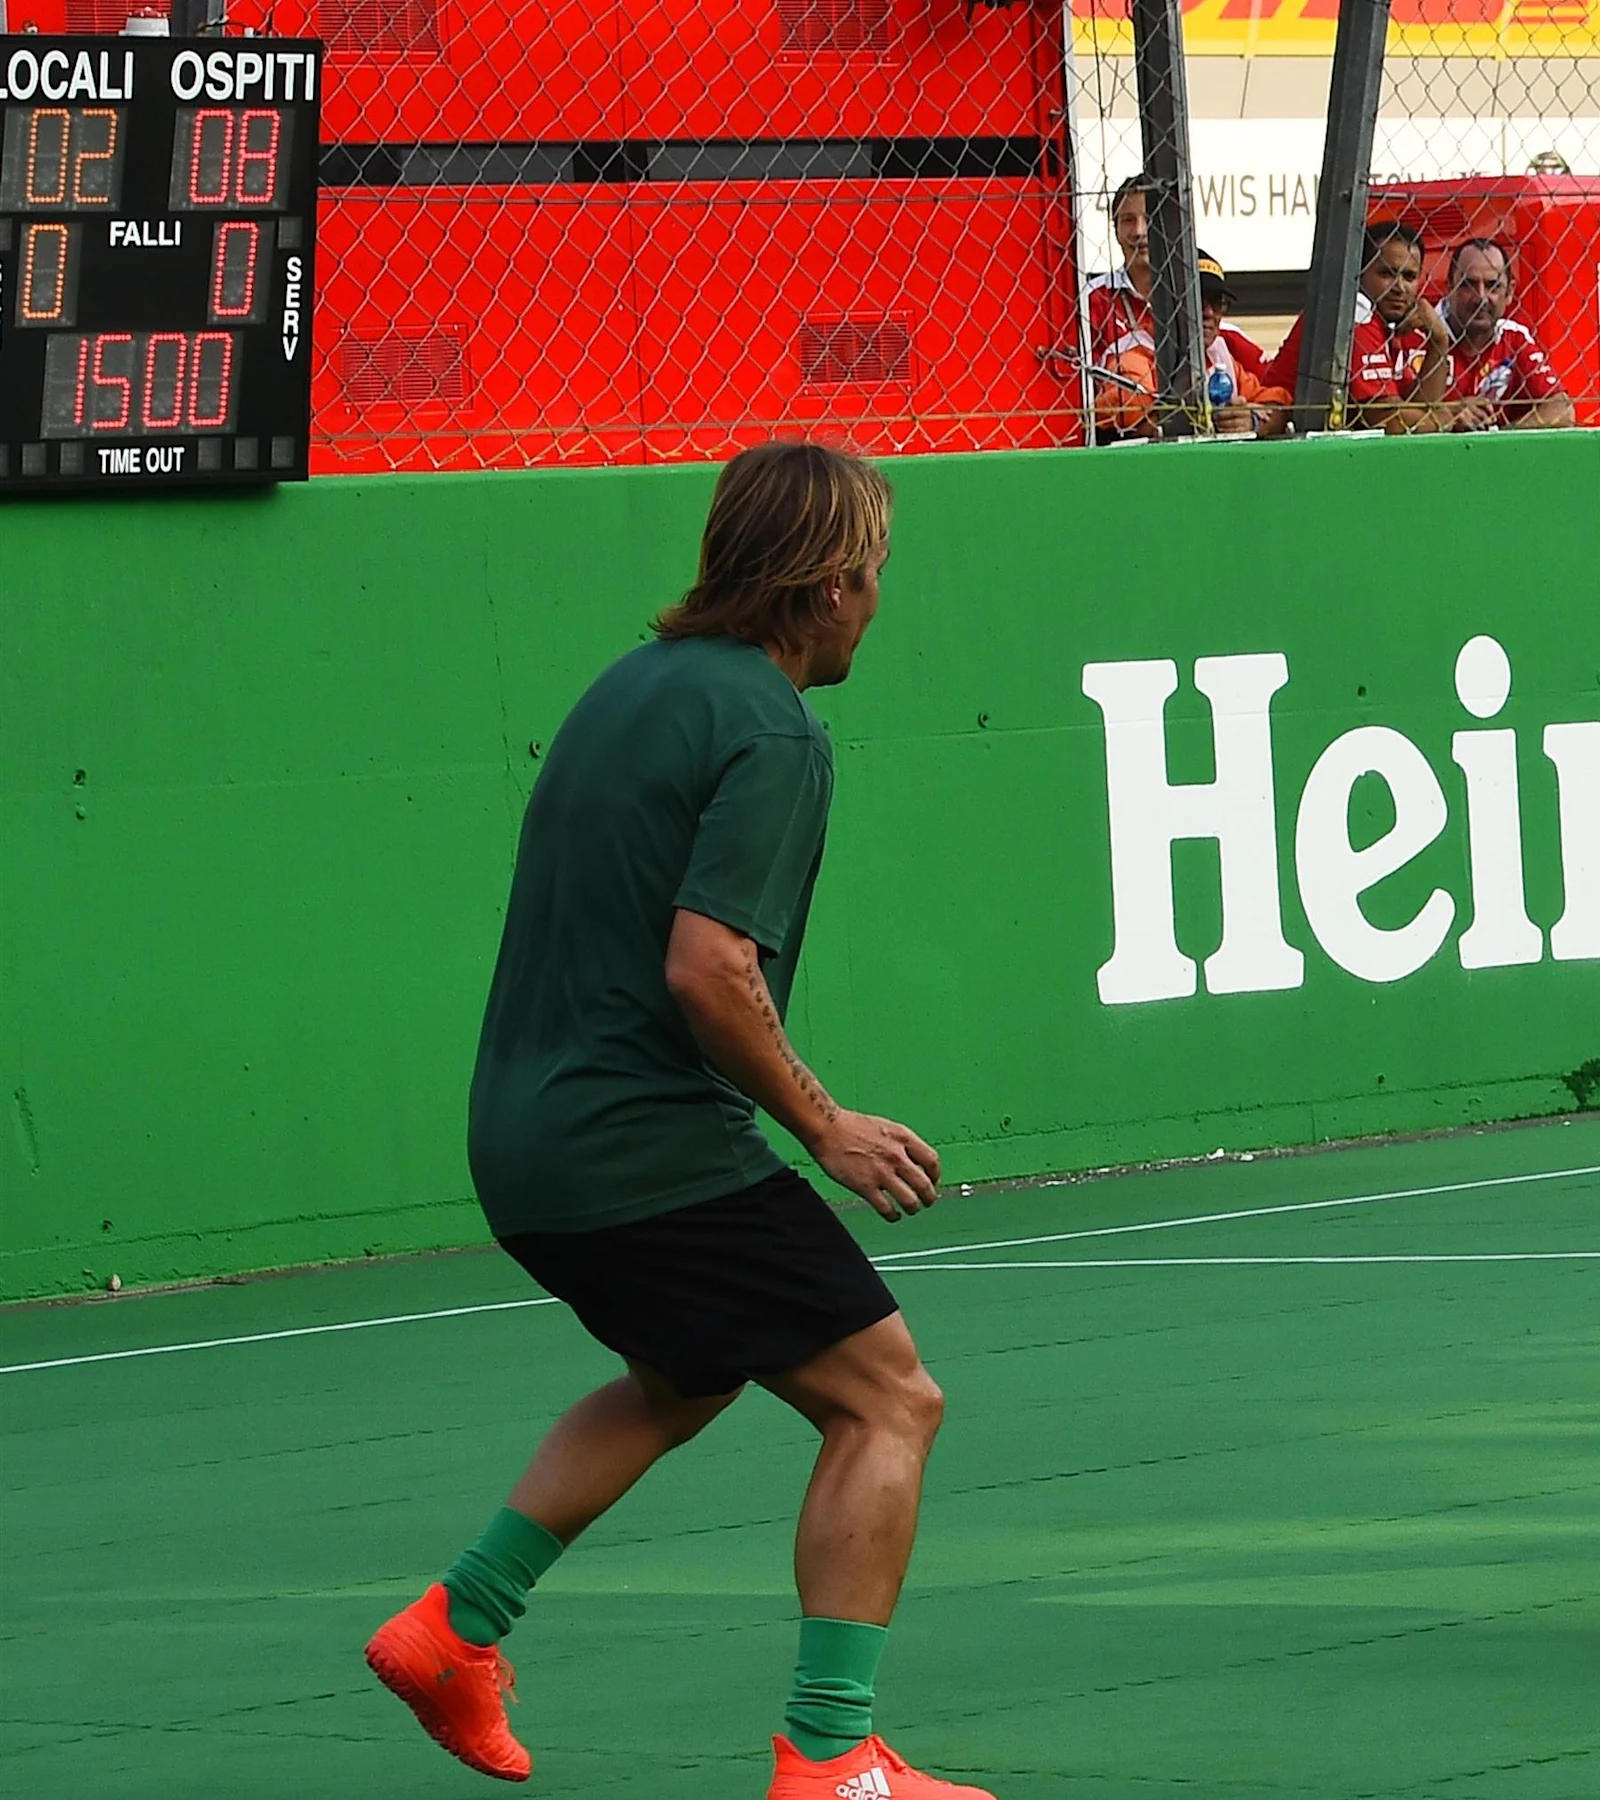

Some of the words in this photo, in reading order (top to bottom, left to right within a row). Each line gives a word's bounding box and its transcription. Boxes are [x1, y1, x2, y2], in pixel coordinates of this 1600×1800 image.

[171, 50, 315, 101] OSPITI
[26, 107, 118, 203] 02
[189, 108, 280, 204] 08
[1198, 174, 1256, 217] WIS
[22, 224, 68, 319] 0
[109, 220, 181, 247] FALLI
[213, 221, 259, 317] 0
[282, 256, 302, 361] SERV
[98, 449, 141, 474] TIME
[145, 447, 185, 473] OUT
